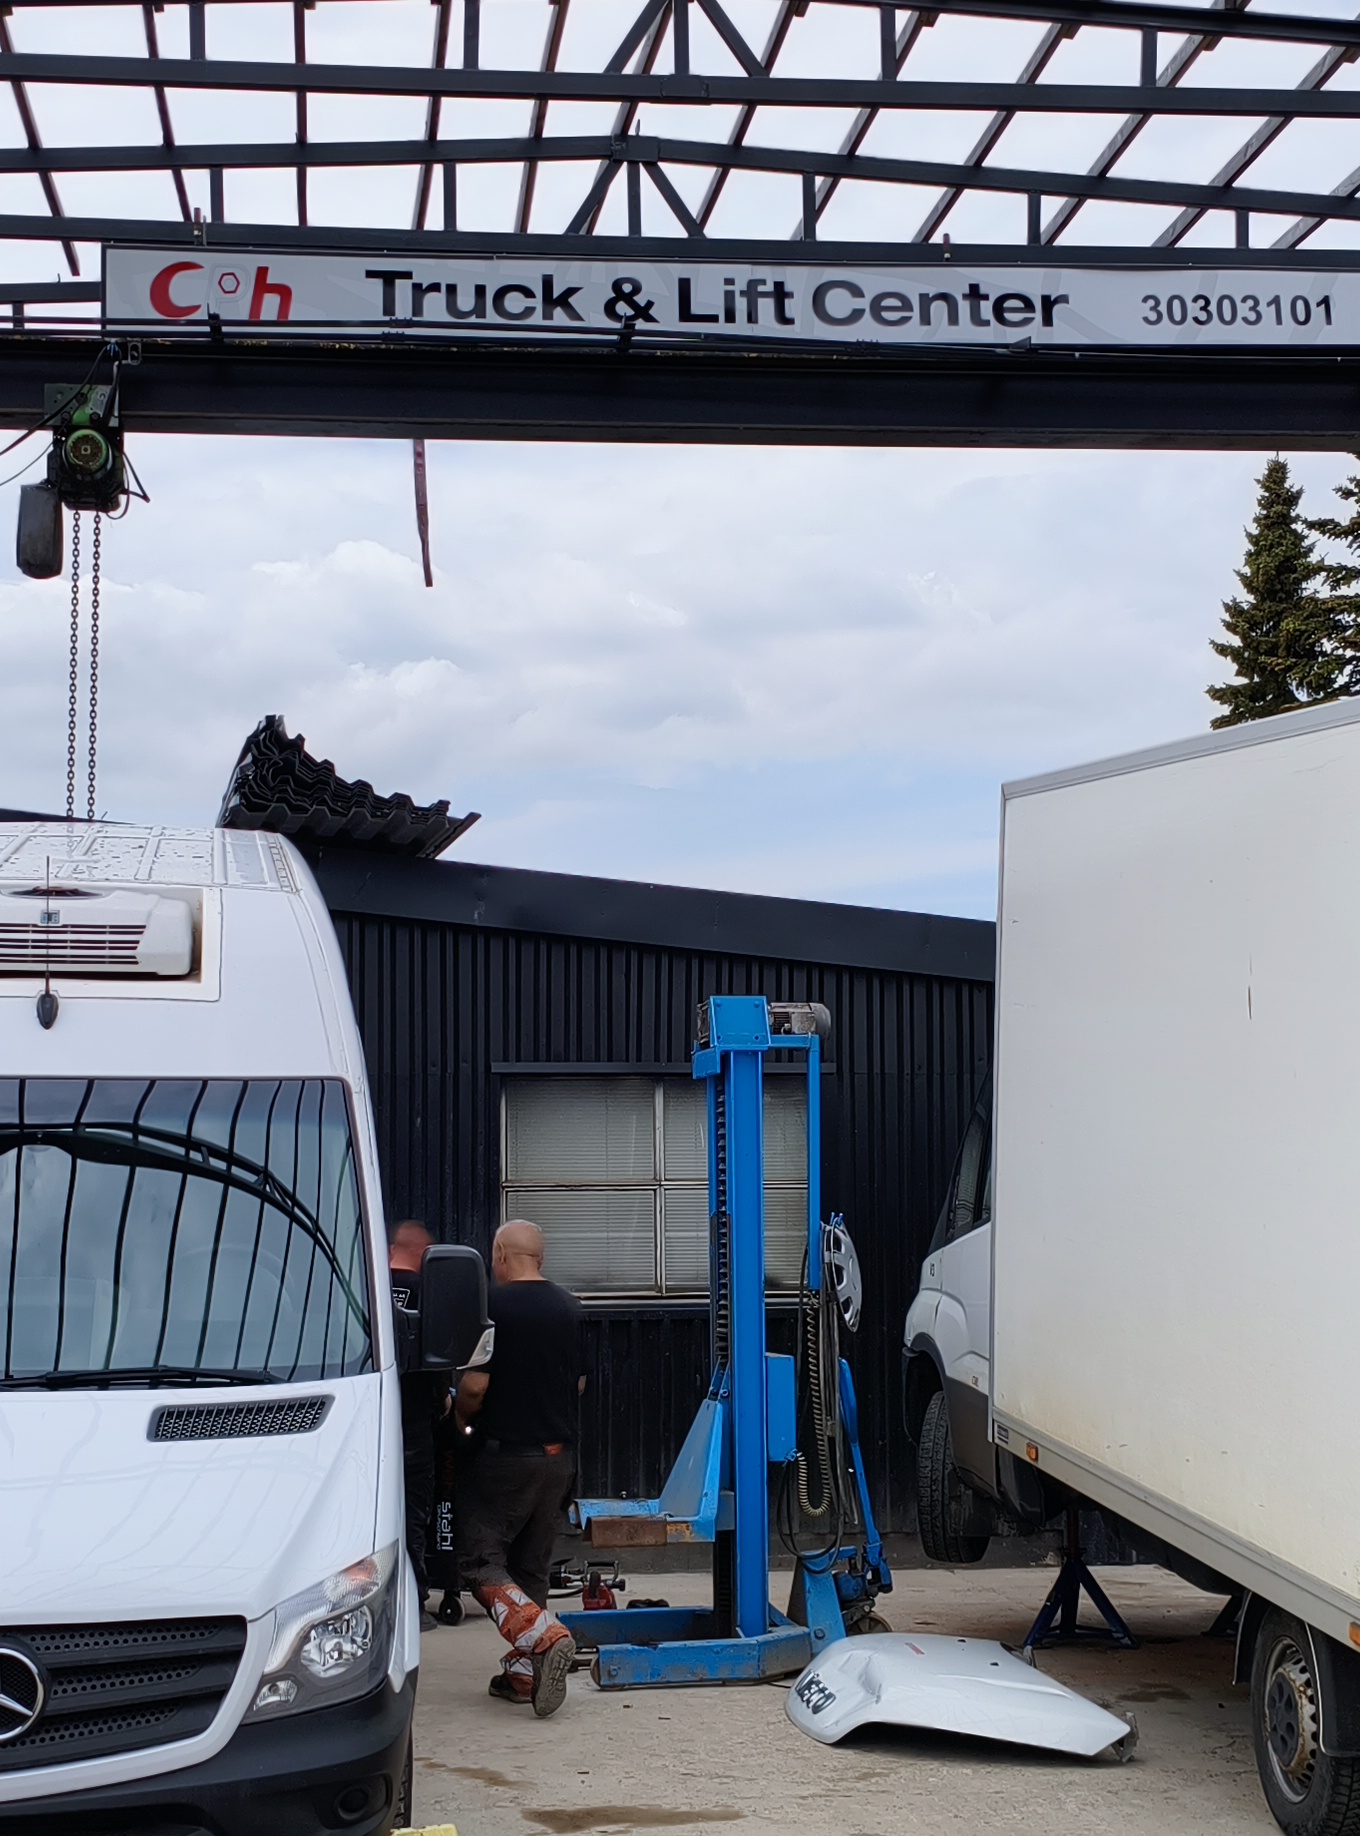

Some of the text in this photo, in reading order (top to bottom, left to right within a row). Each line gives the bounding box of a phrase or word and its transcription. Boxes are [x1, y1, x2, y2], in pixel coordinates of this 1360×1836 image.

[365, 269, 585, 322] Truck
[603, 276, 660, 324] &
[678, 278, 795, 325] Lift
[811, 279, 1070, 328] Center
[1141, 294, 1333, 327] 30303101
[441, 1501, 454, 1551] stahl
